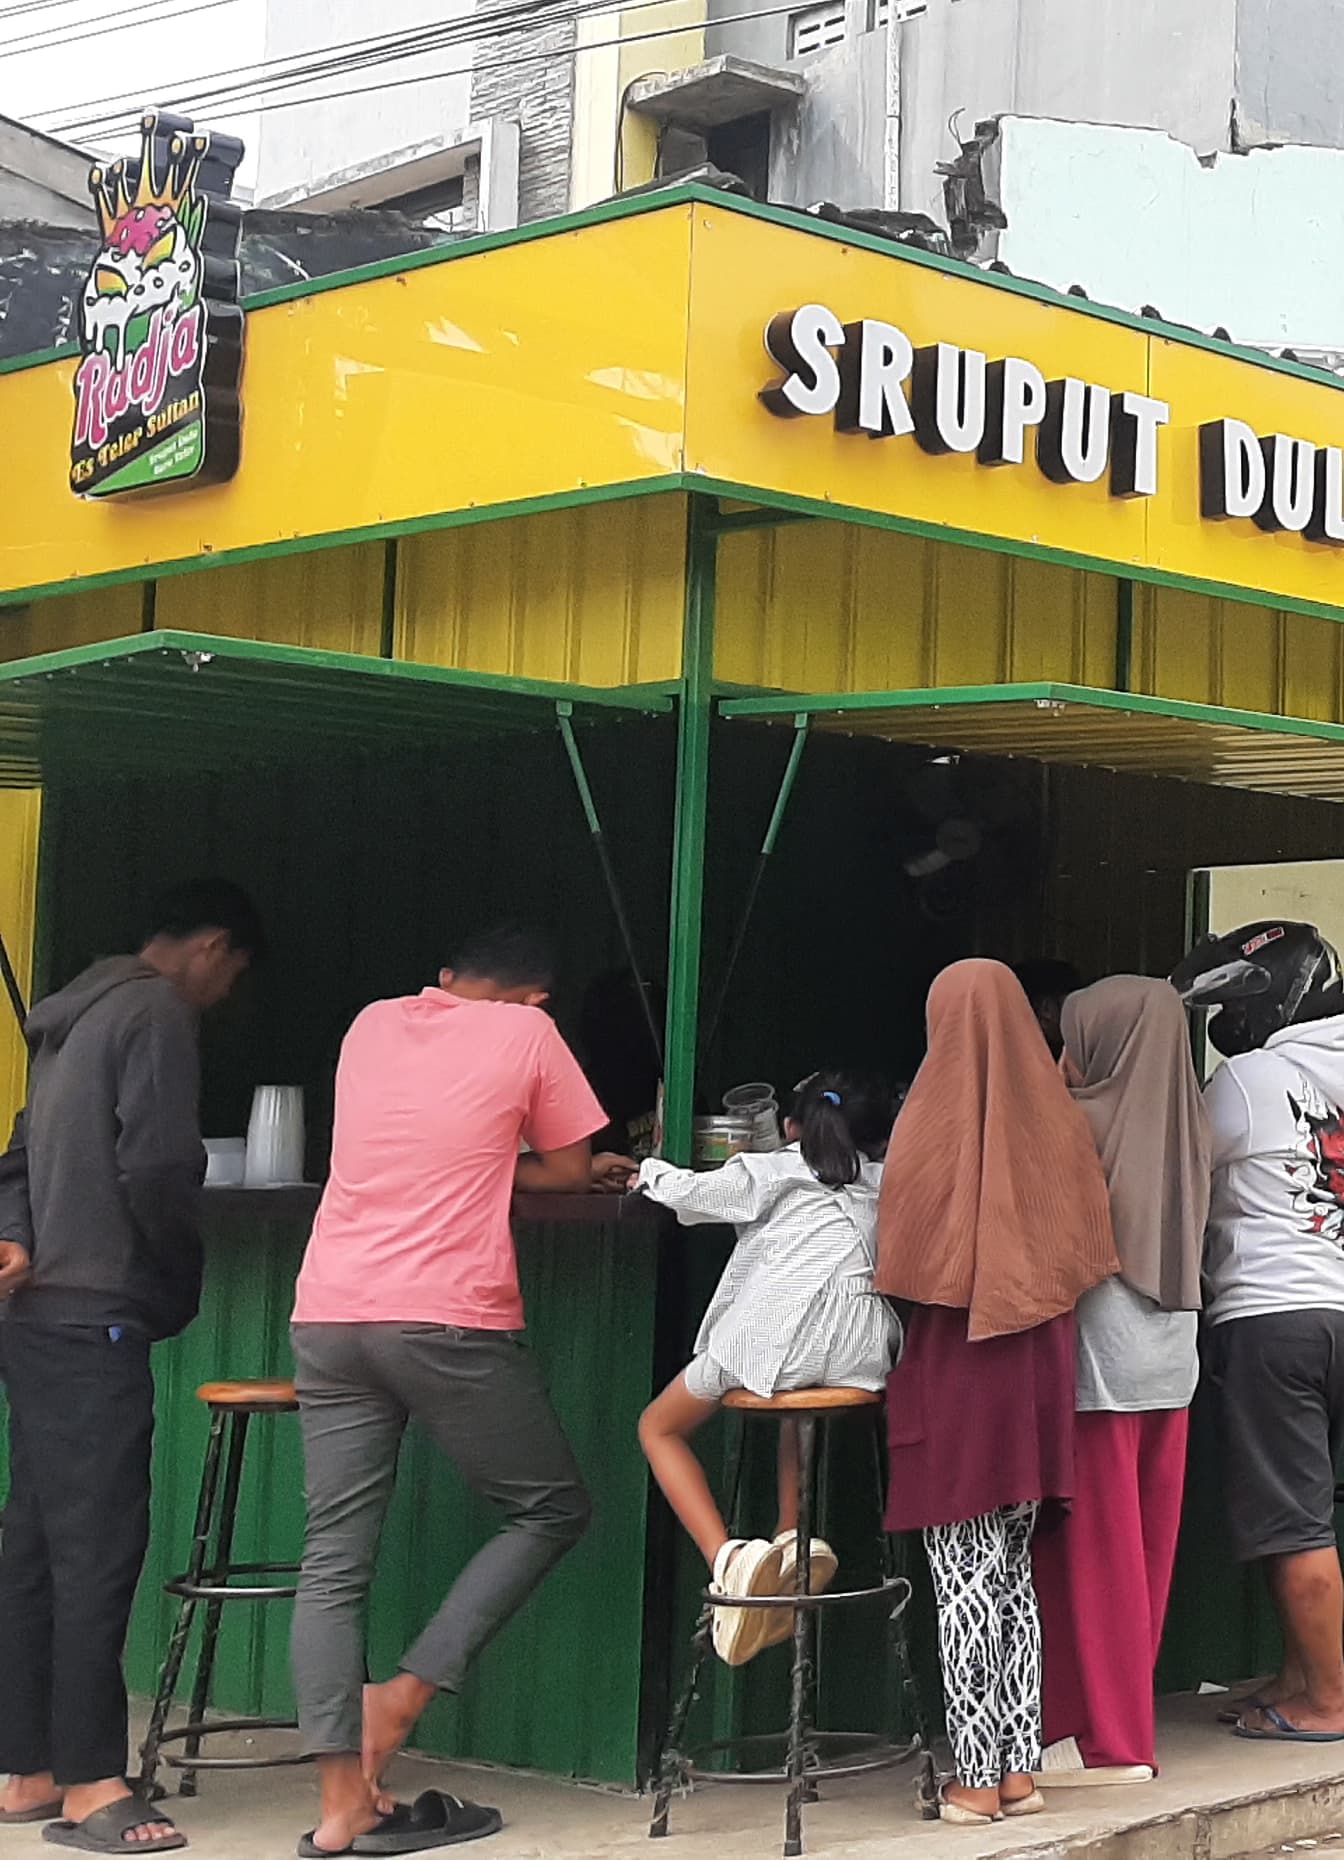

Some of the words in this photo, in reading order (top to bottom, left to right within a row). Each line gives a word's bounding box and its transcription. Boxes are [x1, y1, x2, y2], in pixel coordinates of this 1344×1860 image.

[74, 304, 201, 450] Radja
[146, 390, 199, 438] Sultan
[774, 303, 1169, 497] SRUPUT
